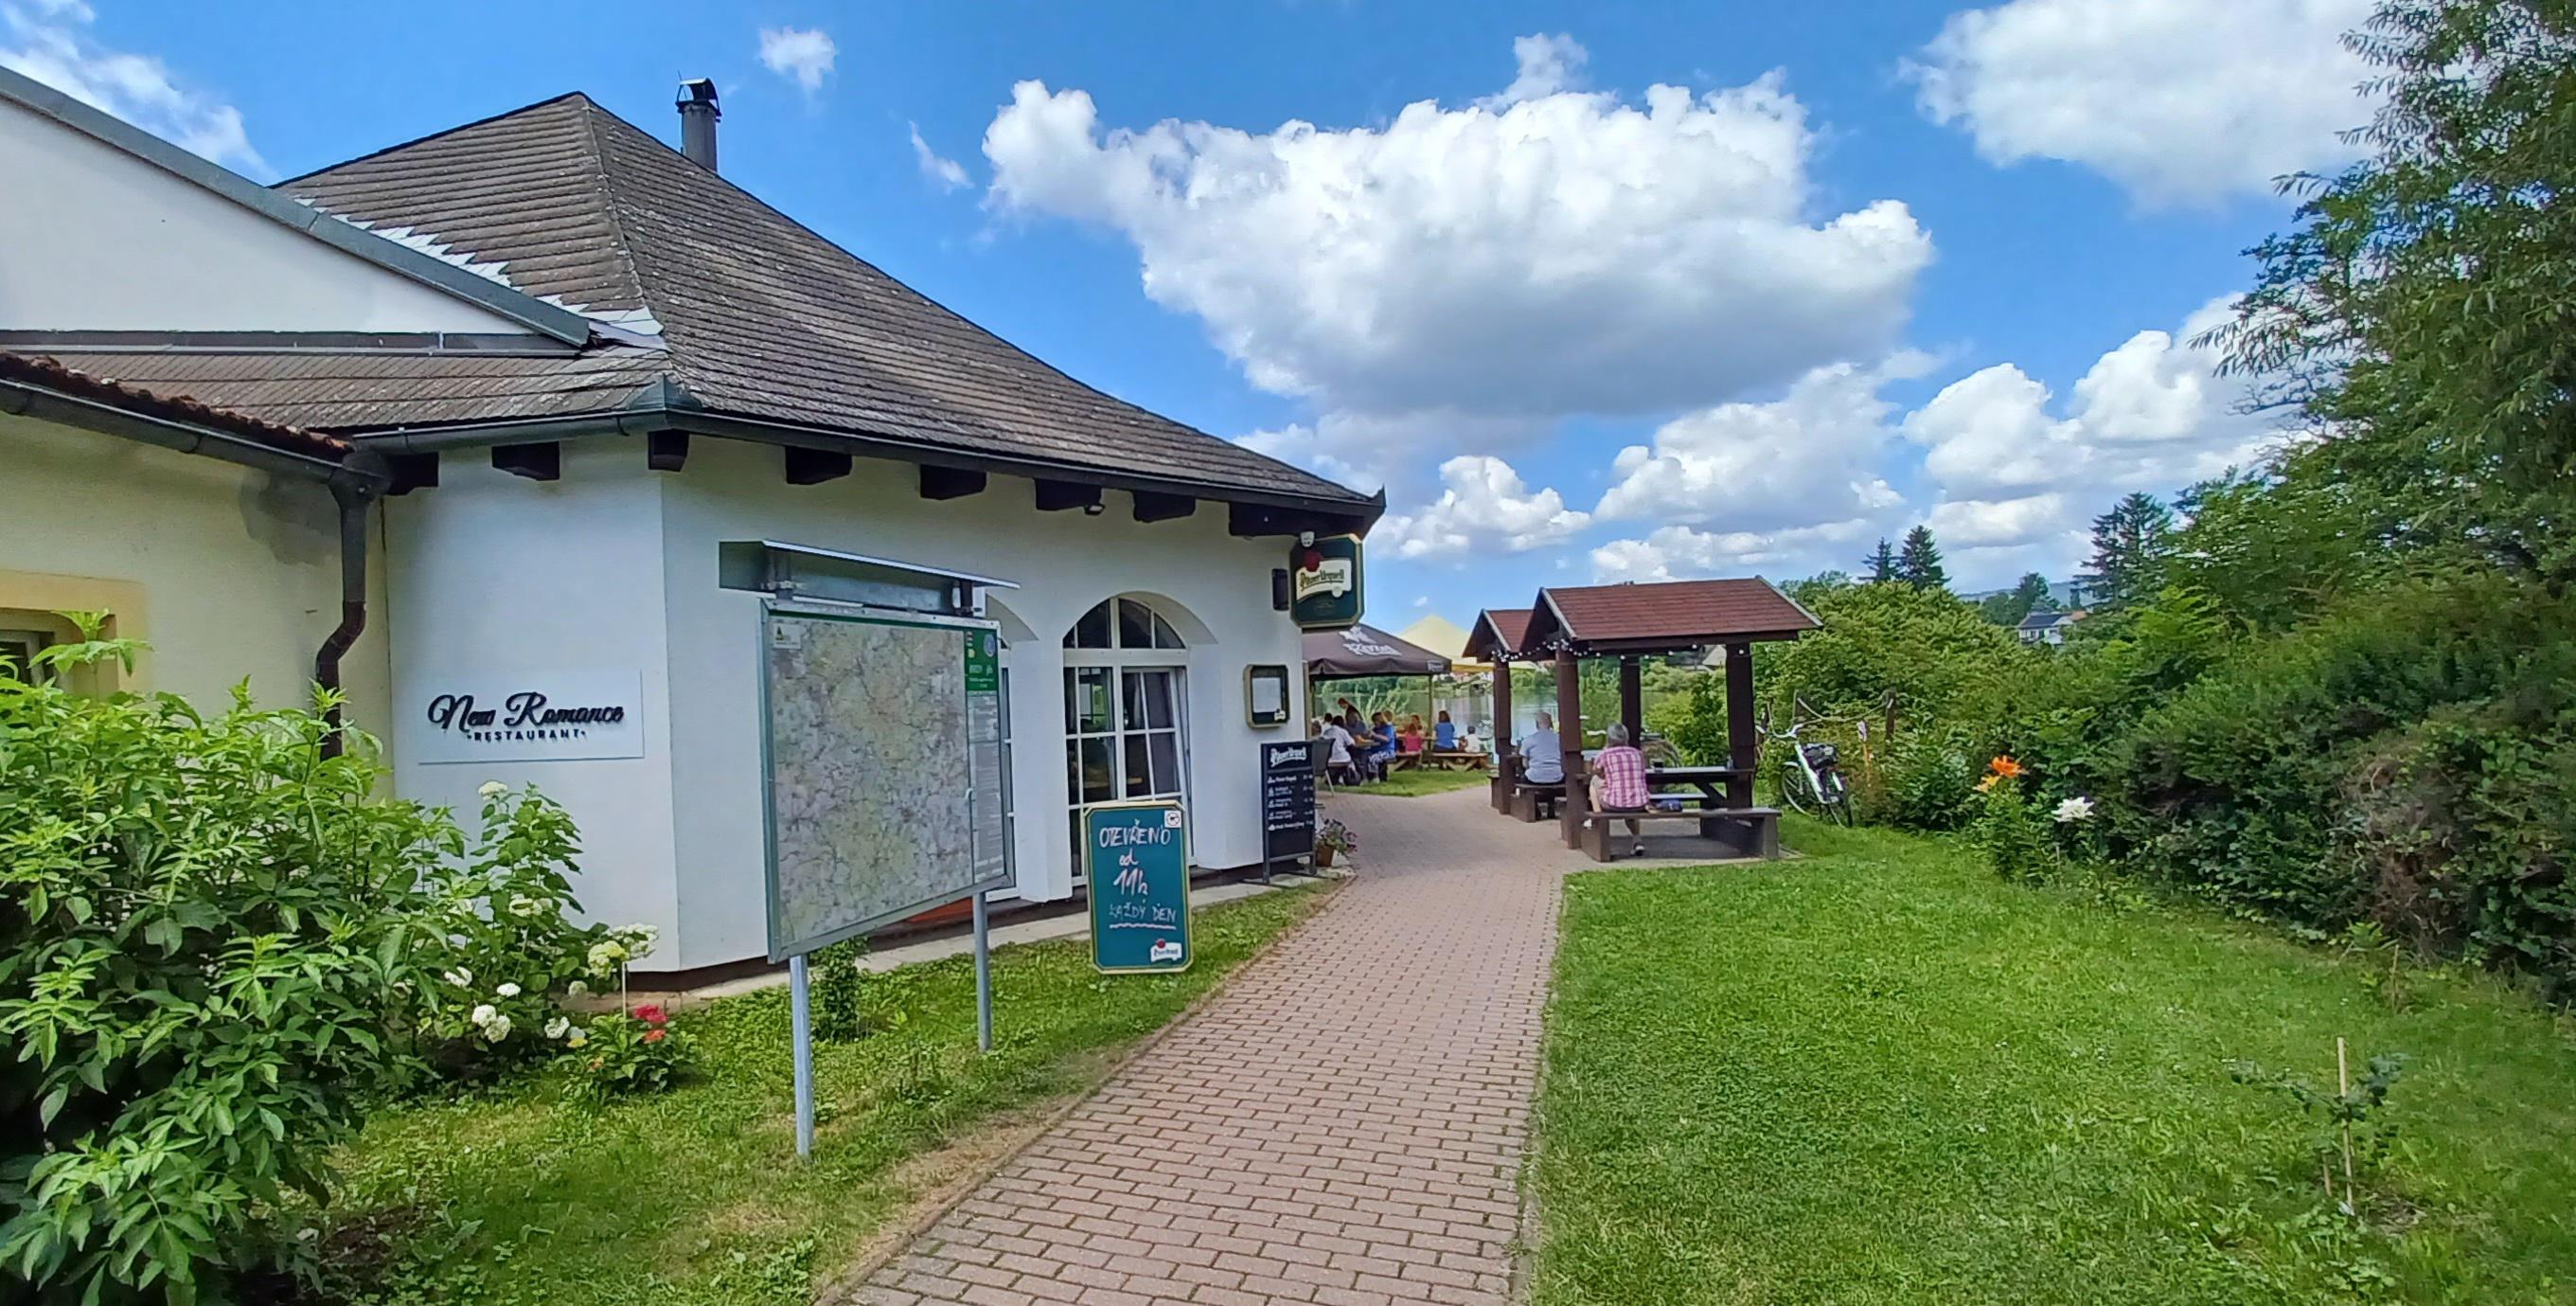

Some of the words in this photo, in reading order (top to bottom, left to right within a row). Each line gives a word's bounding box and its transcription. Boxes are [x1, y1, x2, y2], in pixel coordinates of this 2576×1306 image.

[428, 695, 496, 733] New
[504, 692, 625, 726] Romance
[475, 729, 579, 742] RESTAURANT
[1119, 849, 1139, 867] od
